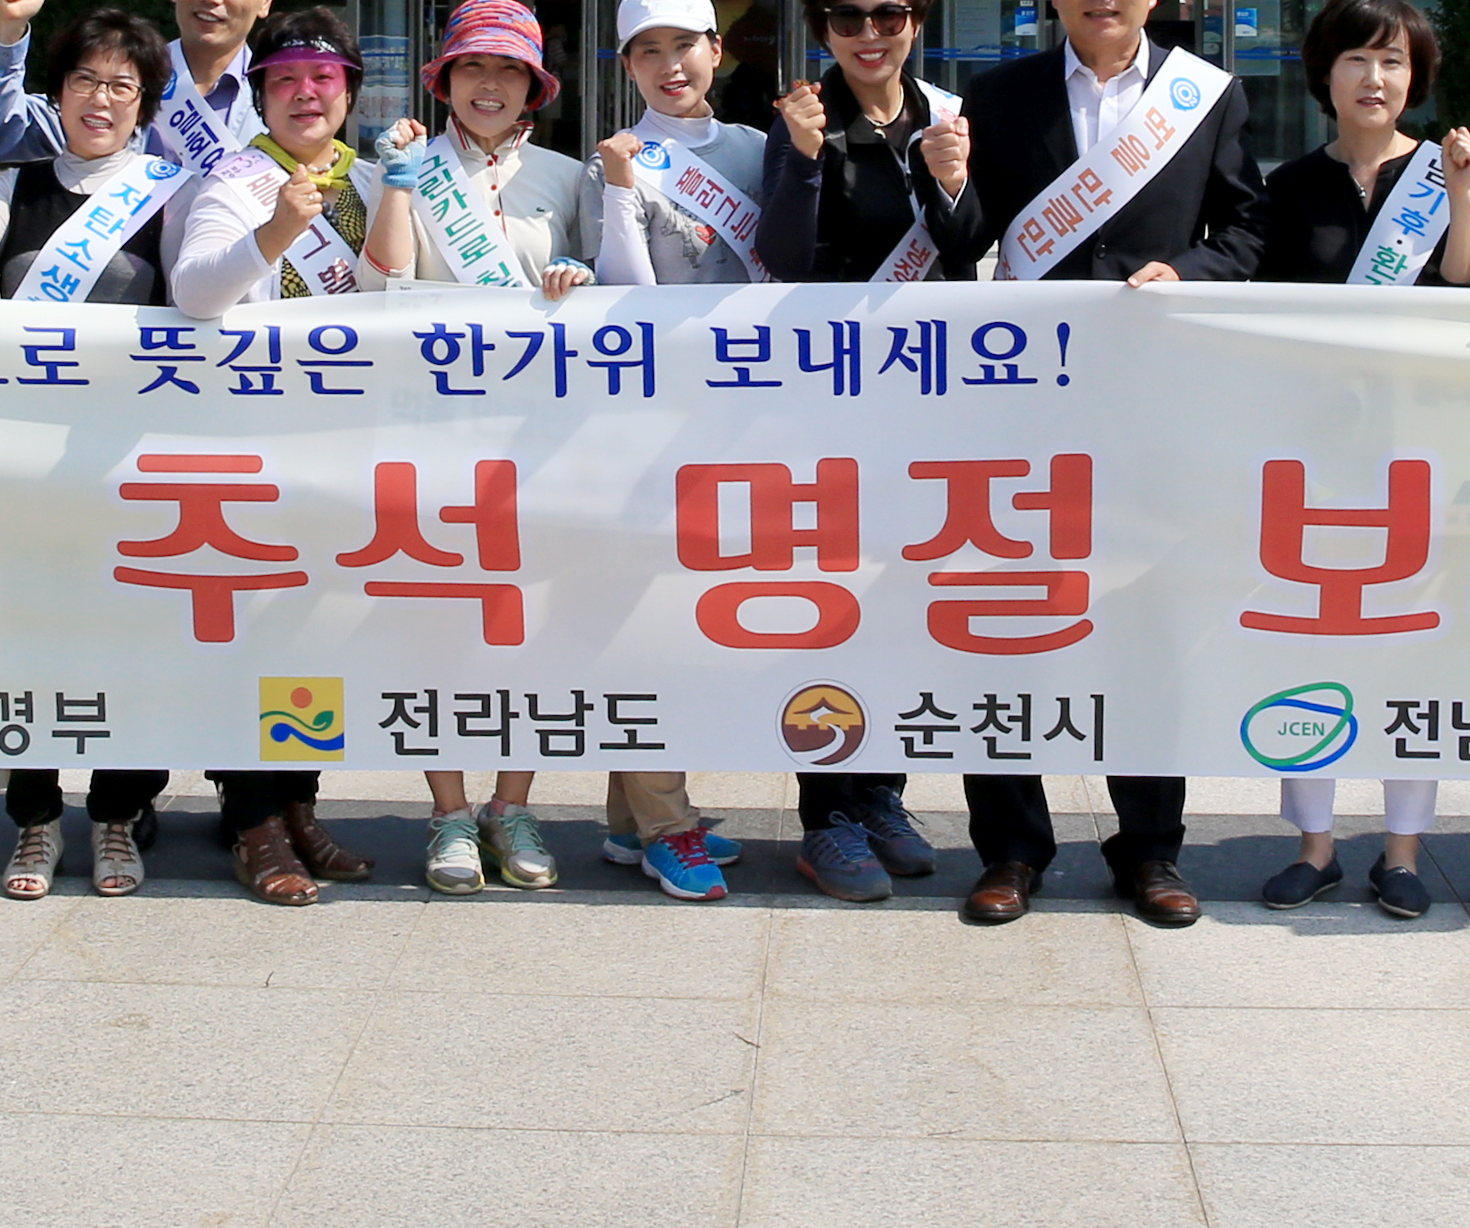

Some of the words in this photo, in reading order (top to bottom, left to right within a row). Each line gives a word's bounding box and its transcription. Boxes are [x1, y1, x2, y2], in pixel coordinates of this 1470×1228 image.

[1110, 106, 1177, 178] 먹을
[417, 154, 499, 269] 그린카드로
[1015, 167, 1115, 263] 만큼만
[133, 326, 371, 395] 뜻깊은
[415, 322, 655, 397] 한가위
[708, 320, 1070, 396] 보내세요!
[115, 455, 524, 645] 추석
[677, 454, 1092, 654] 명절
[380, 690, 665, 756] 전라남도
[895, 693, 1103, 761] 순천시
[1277, 721, 1326, 737] JCEN
